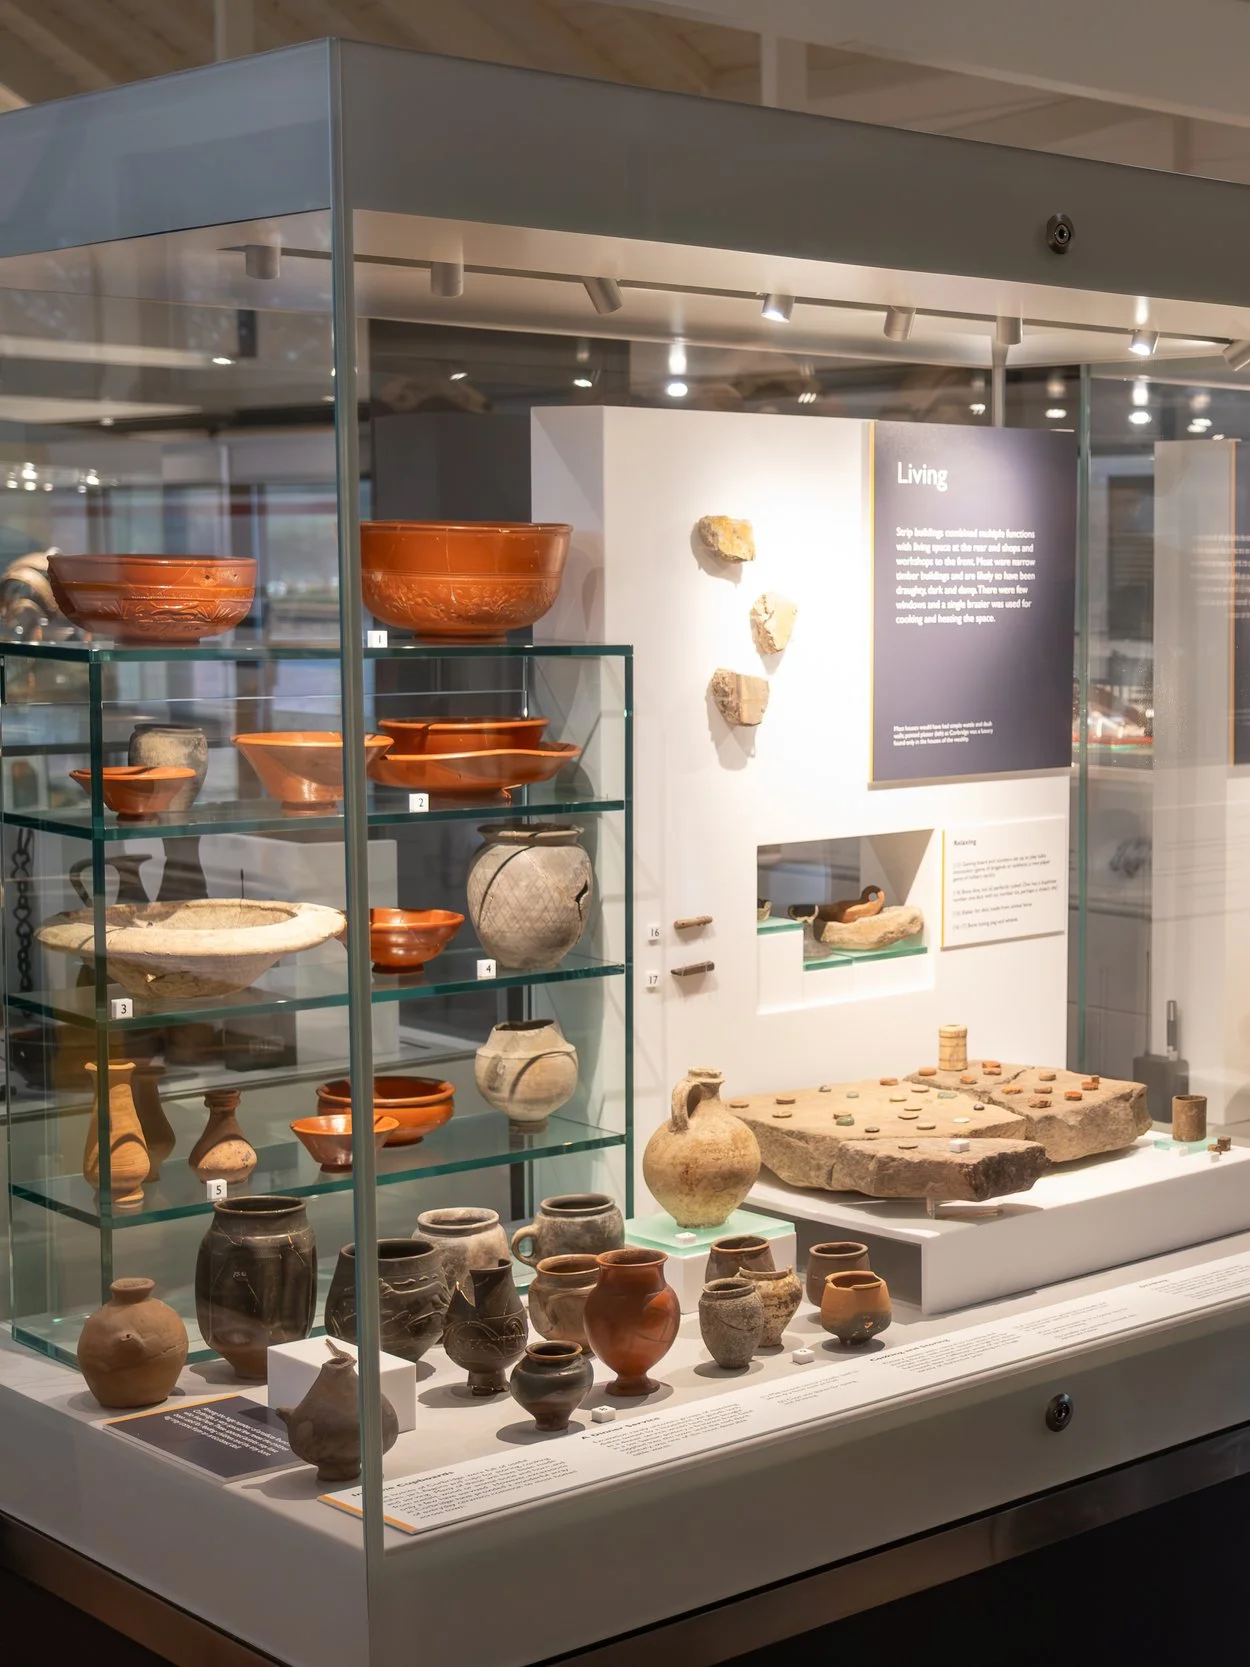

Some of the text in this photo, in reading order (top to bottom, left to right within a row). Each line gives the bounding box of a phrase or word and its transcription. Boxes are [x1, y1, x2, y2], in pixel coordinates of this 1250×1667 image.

[897, 462, 948, 492] Living
[896, 527, 1035, 540] Strip buildings combined multiple functions
[896, 542, 912, 551] with
[913, 542, 930, 554] living
[932, 545, 951, 554] space
[960, 543, 972, 552] the
[988, 543, 1000, 552] and
[1002, 544, 1020, 554] shops
[1022, 544, 1034, 552] and
[896, 558, 933, 568] workshops
[944, 557, 956, 566] the
[896, 572, 919, 580] timber
[921, 572, 949, 582] buildings
[951, 571, 964, 580] and
[977, 572, 993, 582] likely
[1004, 572, 1018, 580] have
[1020, 572, 1035, 580] been
[928, 586, 943, 594] dark
[944, 586, 957, 594] and
[978, 585, 997, 594] There
[1016, 585, 1028, 594] few
[896, 600, 926, 609] windows
[928, 600, 940, 609] and
[947, 600, 966, 611] single
[1005, 599, 1020, 608] used
[1022, 599, 1032, 608] for
[896, 614, 995, 626] cooking and heating the space.
[419, 798, 424, 807] 2
[651, 929, 660, 937] 16
[648, 976, 658, 984] 17
[121, 1004, 127, 1014] 3
[216, 1185, 221, 1195] 5
